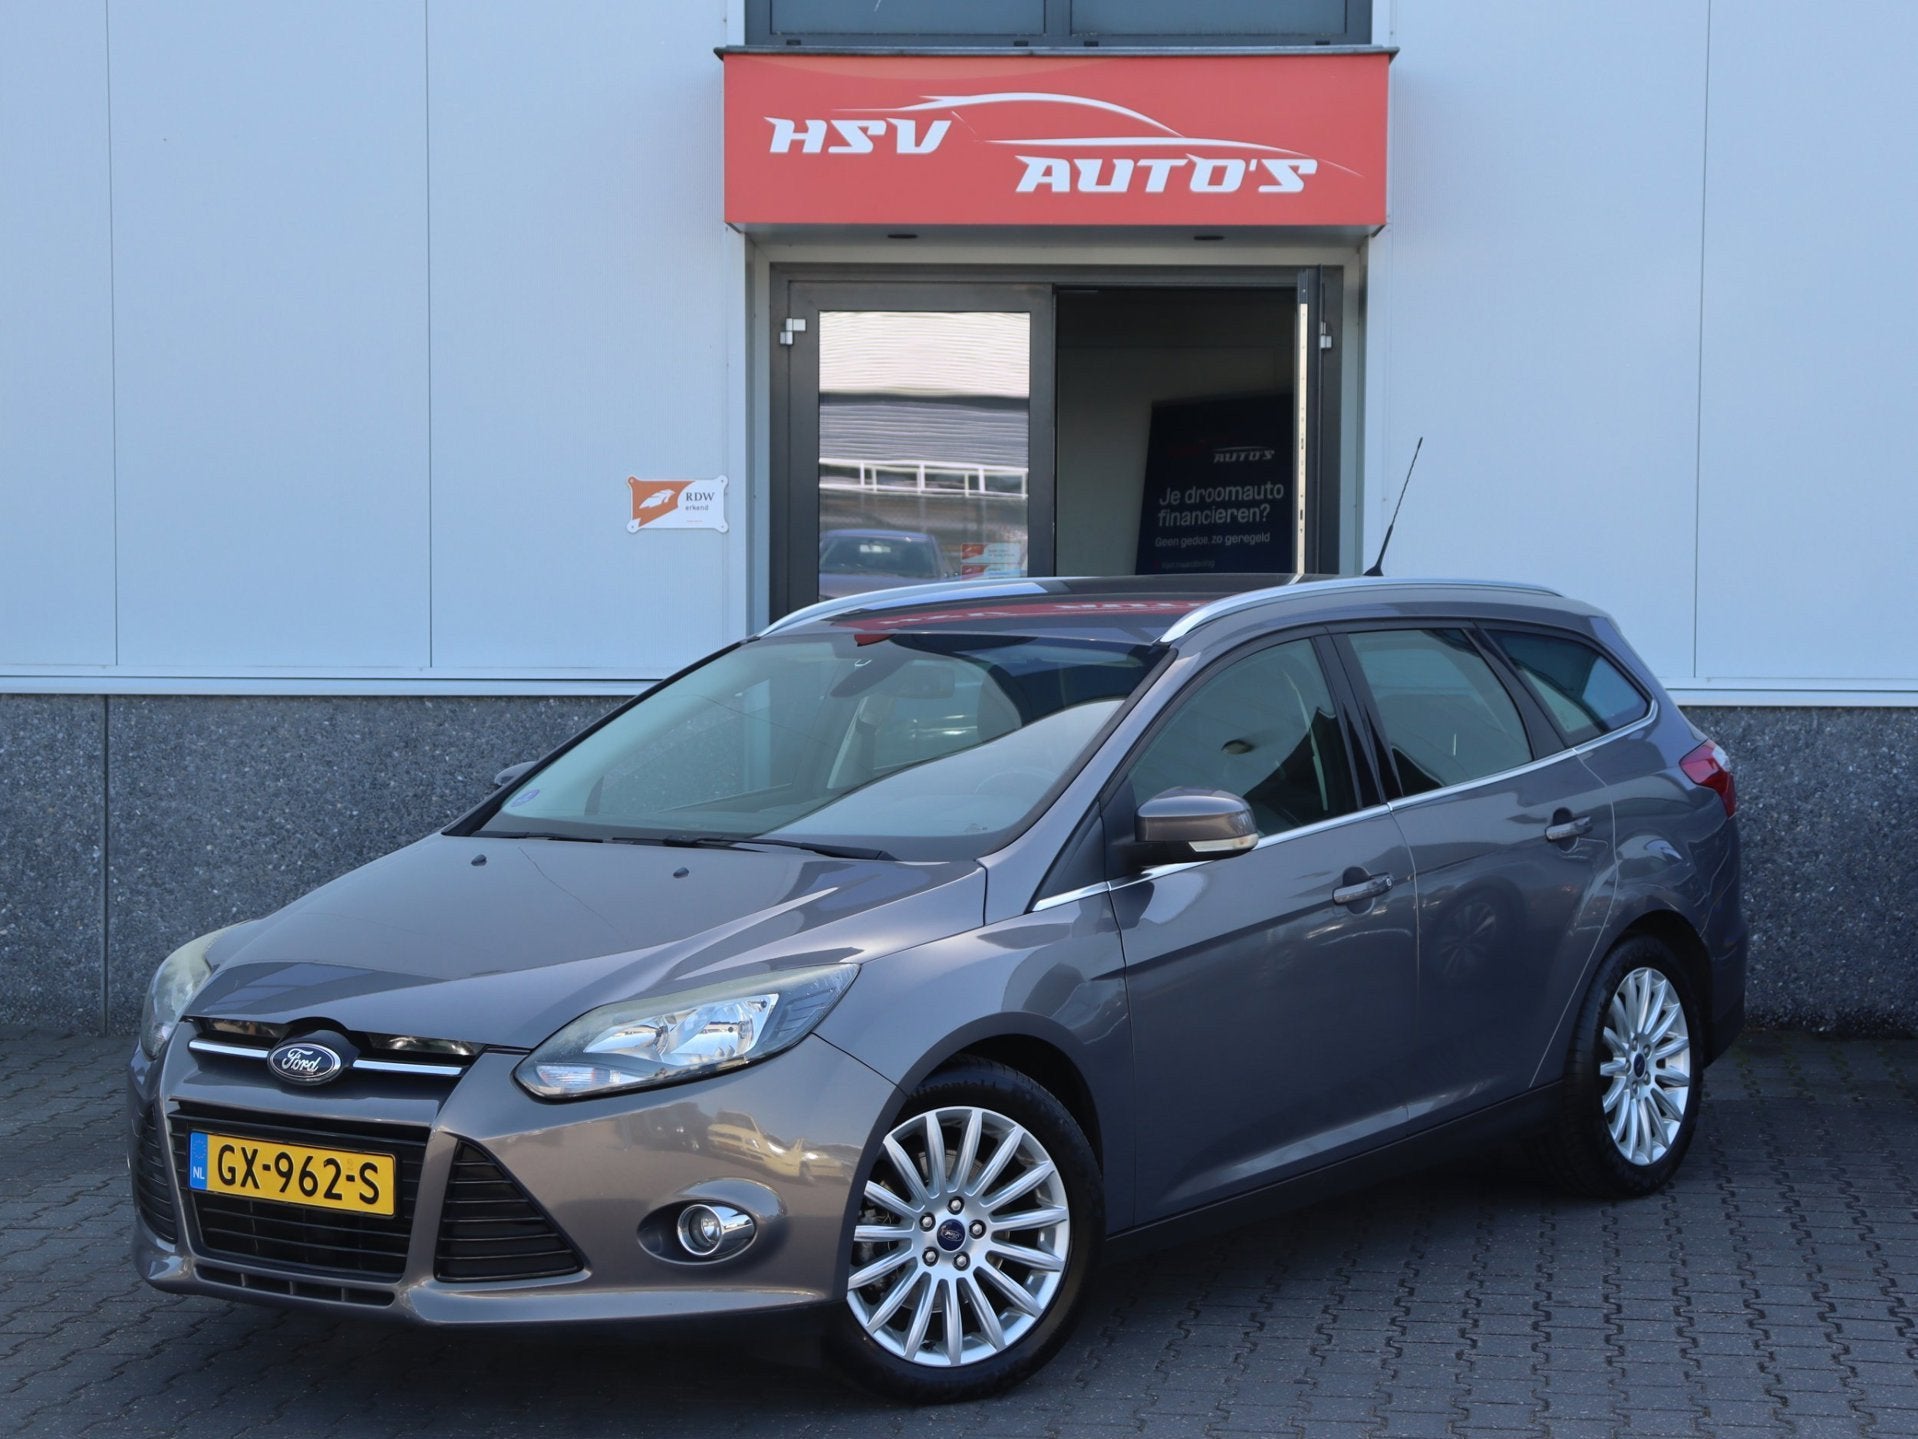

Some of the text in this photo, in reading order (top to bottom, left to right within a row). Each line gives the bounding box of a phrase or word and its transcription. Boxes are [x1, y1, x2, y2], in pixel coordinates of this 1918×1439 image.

[764, 116, 952, 154] HSV
[1014, 153, 1318, 193] AUTO'S
[686, 492, 715, 501] RDW
[1159, 482, 1284, 506] Je droomauto
[1158, 504, 1270, 527] financieren?
[1155, 537, 1179, 547] Geen
[1211, 534, 1223, 544] zo
[1225, 532, 1270, 546] geregeld
[281, 1048, 322, 1072] Ford
[192, 1166, 206, 1180] NL
[217, 1144, 380, 1205] GX-962-S
